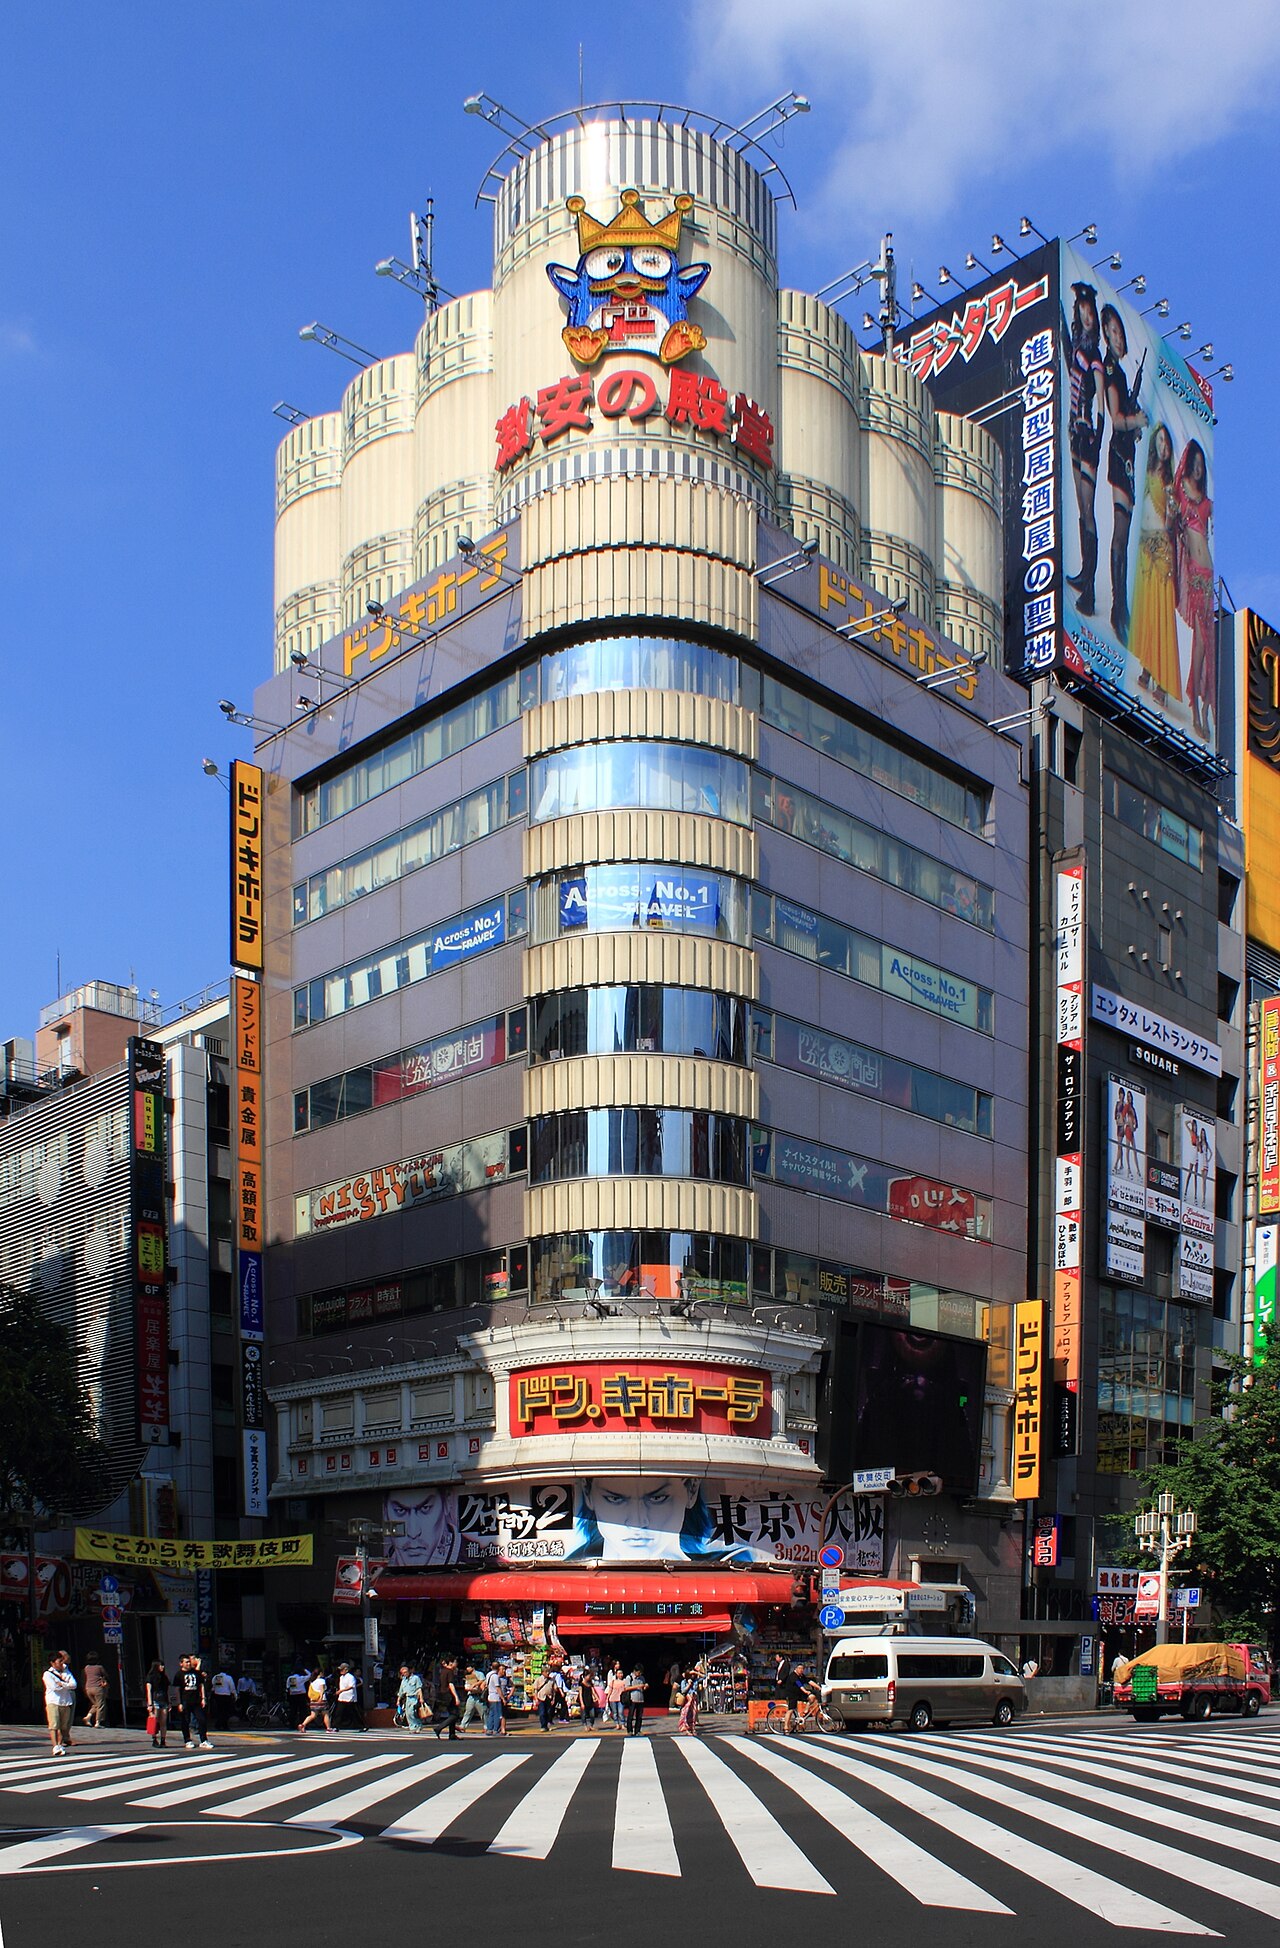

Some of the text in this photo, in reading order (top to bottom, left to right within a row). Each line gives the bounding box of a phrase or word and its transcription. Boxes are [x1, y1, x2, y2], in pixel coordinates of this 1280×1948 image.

[494, 367, 775, 472] 激安の殿堂
[1021, 329, 1056, 668] 進化型居酒屋の聖地
[564, 880, 709, 909] Across No.1
[622, 901, 697, 919] TRAVEL
[1070, 883, 1080, 948] バドワイザー
[434, 910, 501, 953] Across No.1
[460, 930, 495, 951] TRAVEL
[1060, 917, 1069, 972] カーニバル
[890, 959, 967, 1002] Across No.1
[921, 988, 960, 1014] TRAVEL
[1069, 994, 1079, 1022] アジア
[241, 986, 256, 1067] ブランド品
[1059, 999, 1069, 1040] クッション
[1096, 994, 1219, 1062] エンタメレストランタワー
[1135, 1046, 1179, 1076] SQUARE
[1064, 1055, 1075, 1142] ザ・ロックアップ
[241, 1086, 256, 1148] 貴金属
[320, 1165, 398, 1215] NIGHT
[361, 1168, 441, 1220] STYLE
[1063, 1167, 1073, 1206] 手羽一郎
[242, 1171, 257, 1243] 高額買取
[1182, 1213, 1213, 1232] Carnival
[145, 1284, 159, 1294] 6F
[248, 1256, 260, 1324] Across No.1
[377, 1286, 401, 1302] 時計
[819, 1271, 847, 1296] 販売
[852, 1283, 881, 1299] ブランド
[349, 1294, 373, 1310] ブランド
[1061, 1281, 1073, 1367] アラビアンロック
[1061, 1397, 1069, 1449] ミステリアス
[857, 1471, 891, 1483] 歌舞伎町
[250, 1497, 261, 1509] 5F
[212, 1539, 302, 1560] 歌舞伎町
[466, 1540, 564, 1558] 龍が如く 阿修羅編
[775, 1542, 817, 1563] 3月22日
[825, 1611, 836, 1625] P
[1083, 1637, 1090, 1652] P
